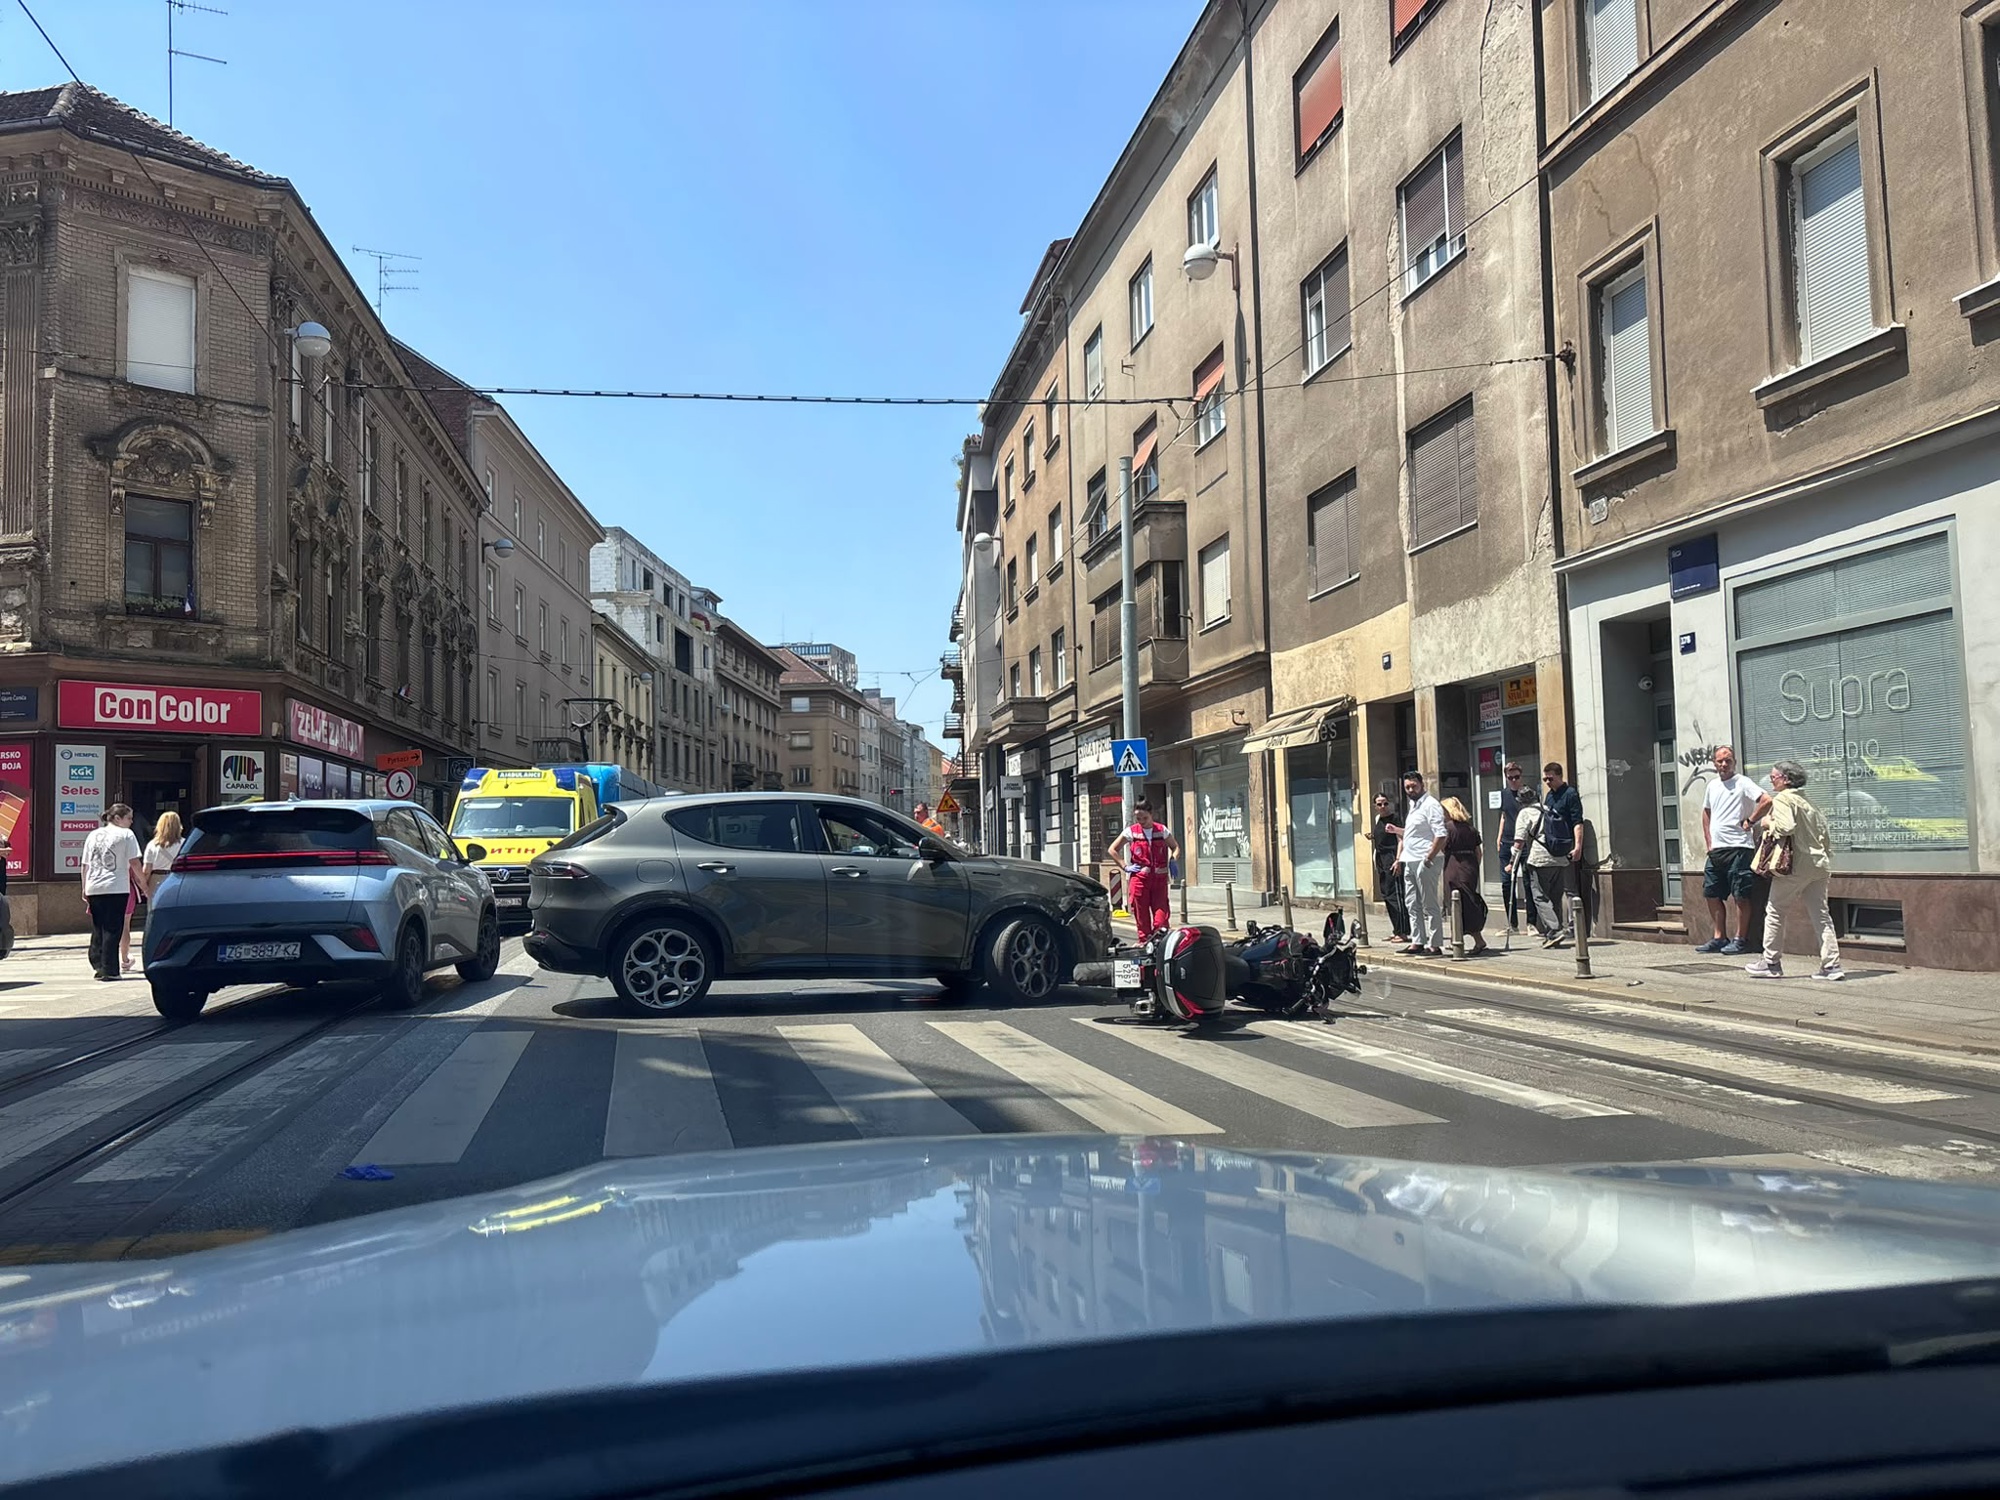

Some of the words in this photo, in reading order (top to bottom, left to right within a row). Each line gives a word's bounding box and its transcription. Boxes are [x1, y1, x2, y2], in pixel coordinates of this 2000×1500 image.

[1780, 667, 1911, 730] Supra
[1811, 738, 1880, 760] STUDIO
[0, 751, 21, 759] RSKO
[2, 762, 22, 770] BOJA
[71, 767, 92, 776] KGK
[500, 771, 541, 779] AMBULANCE
[61, 785, 100, 795] Seles
[226, 946, 243, 959] ZG
[283, 943, 299, 956] KZ
[1122, 963, 1132, 985] 5267
[1131, 967, 1140, 978] ZG
